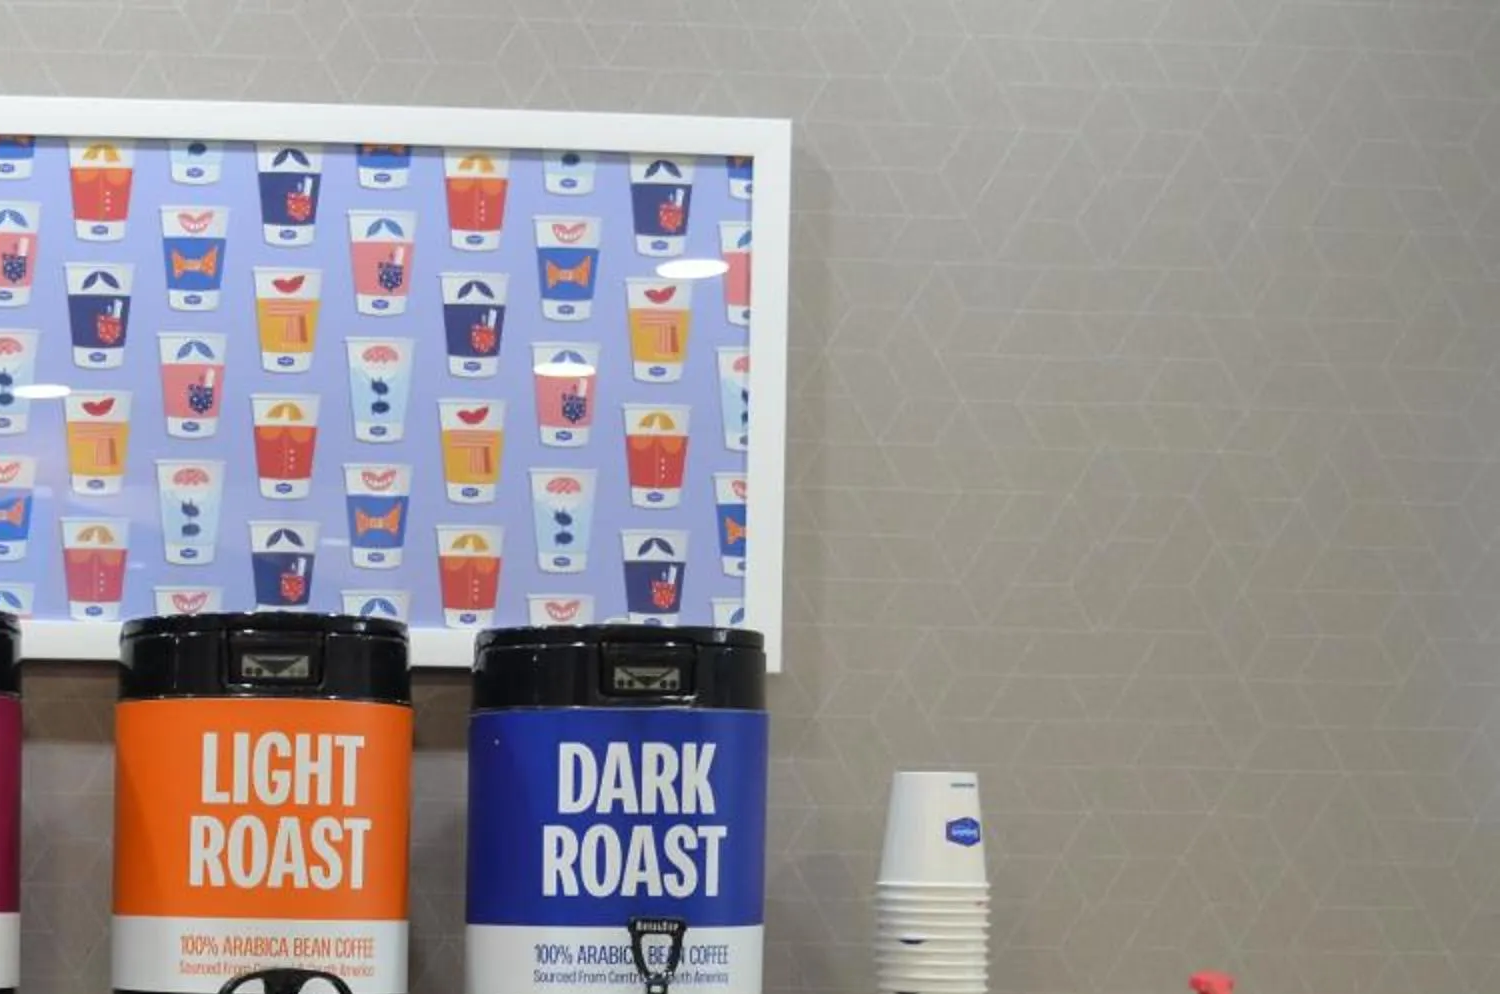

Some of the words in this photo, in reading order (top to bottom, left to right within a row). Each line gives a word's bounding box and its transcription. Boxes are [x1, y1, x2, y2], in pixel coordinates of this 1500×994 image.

[201, 731, 365, 806] LIGHT
[557, 741, 716, 814] DARK
[189, 815, 372, 890] ROAST
[542, 824, 727, 899] ROAST
[180, 935, 218, 956] 100%
[222, 936, 289, 957] ARABICA
[293, 937, 331, 957] BEAN
[335, 938, 375, 958] COFFEE
[534, 943, 573, 964] 100%
[577, 945, 634, 965] ARABIC
[689, 945, 729, 965] COFFEE
